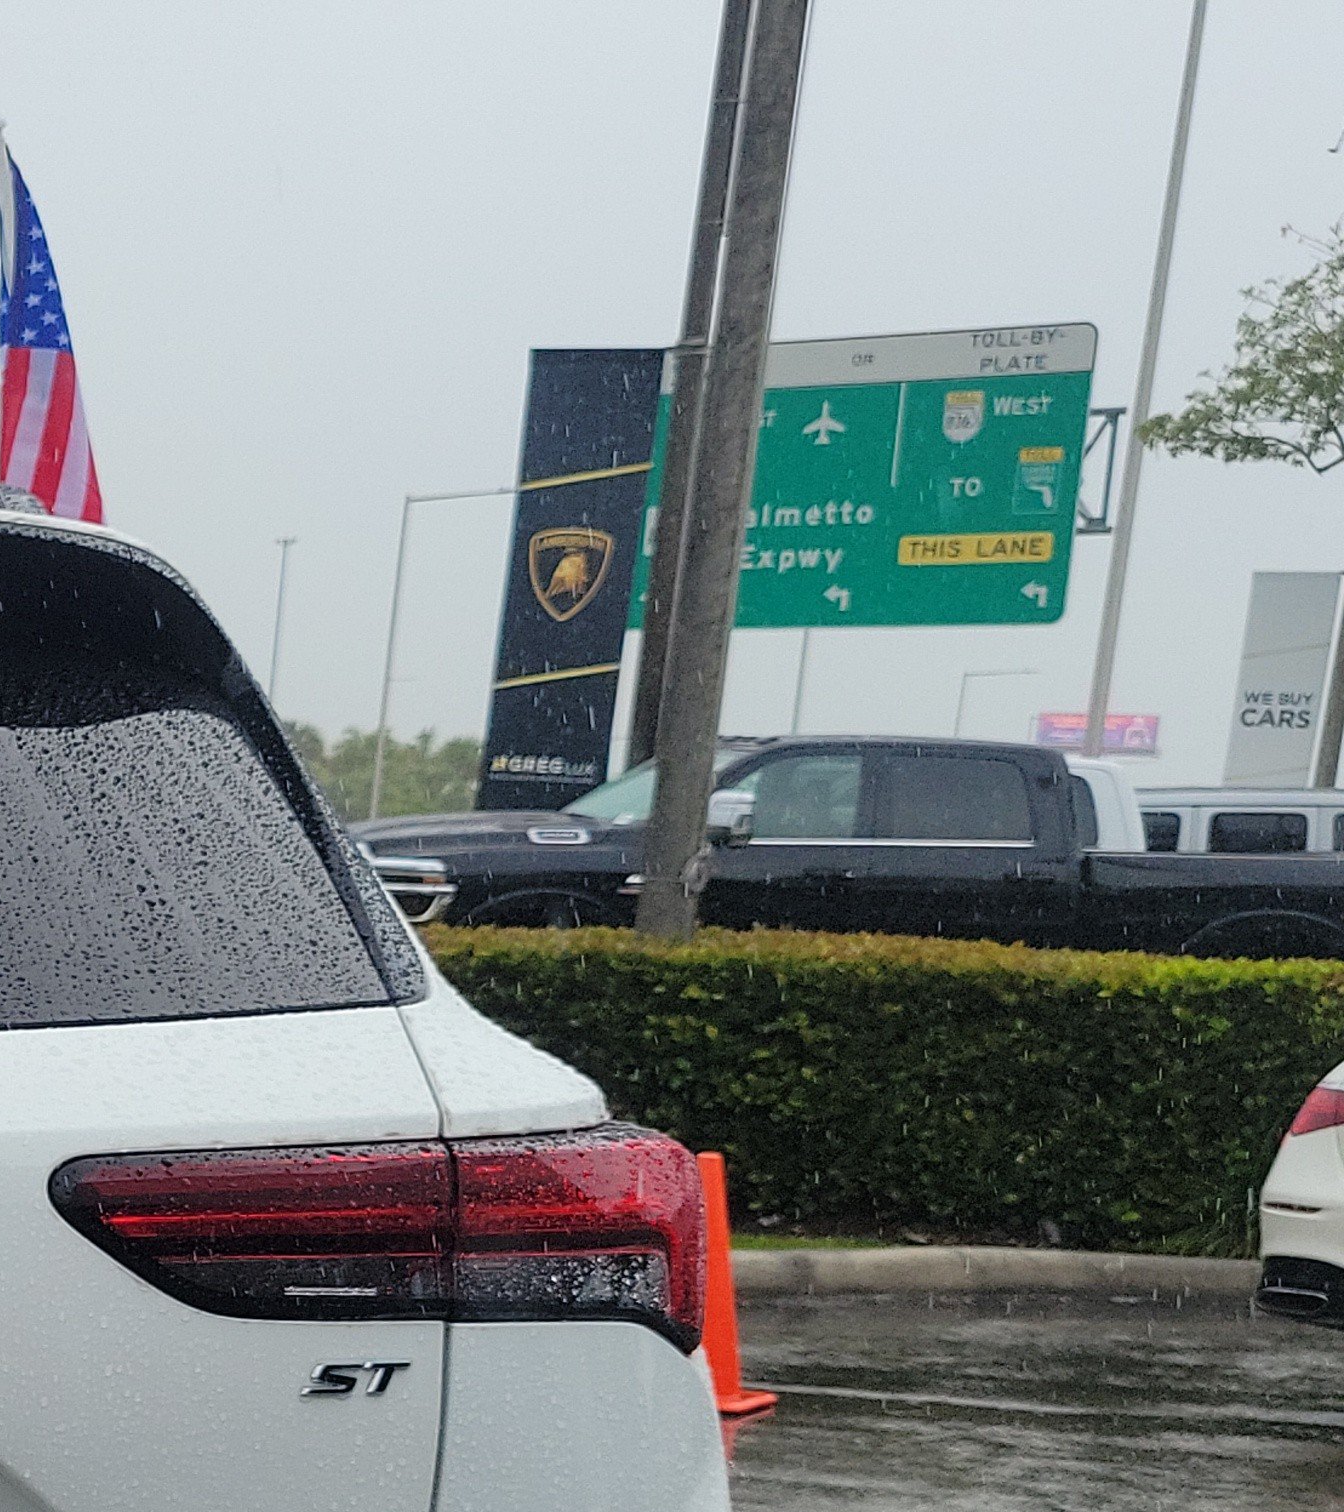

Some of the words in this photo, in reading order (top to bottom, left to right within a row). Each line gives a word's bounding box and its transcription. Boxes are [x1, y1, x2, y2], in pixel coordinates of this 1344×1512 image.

[979, 353, 1048, 372] PLATE
[993, 394, 1052, 416] WEST
[951, 476, 982, 497] TO
[743, 500, 874, 529] almetto
[909, 539, 961, 558] THIS
[976, 537, 1044, 558] LANE
[739, 543, 843, 574] Expwy
[1245, 691, 1274, 705] WE
[1278, 692, 1313, 705] BUY
[1240, 708, 1311, 729] CARS
[300, 1361, 411, 1396] ST
